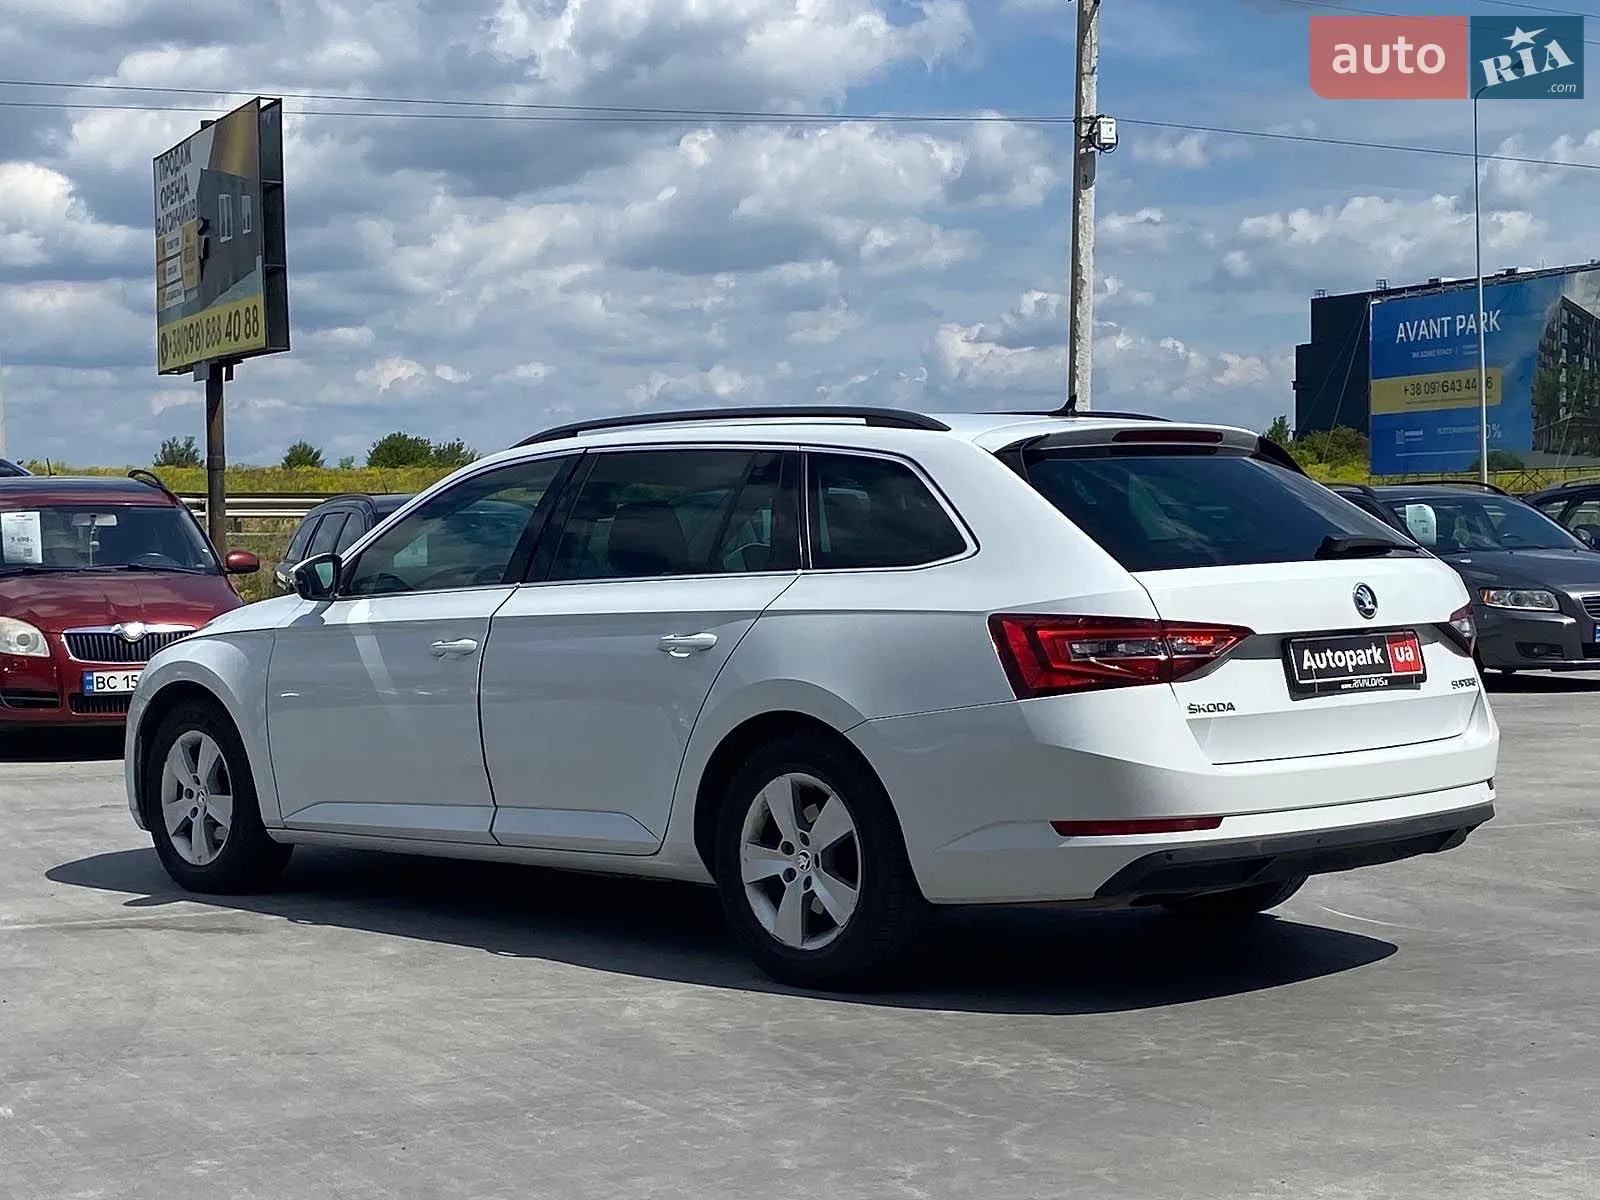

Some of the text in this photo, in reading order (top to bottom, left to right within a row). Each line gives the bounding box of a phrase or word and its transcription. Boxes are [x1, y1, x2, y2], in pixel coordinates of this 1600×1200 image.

[158, 141, 193, 182] ПРОДАЖ
[160, 172, 190, 209] ОРЕНДА
[225, 309, 241, 342] 40
[244, 304, 260, 338] 88
[1395, 309, 1502, 344] AVANT PARK
[1302, 641, 1415, 673] Autopark ua
[95, 675, 118, 690] BC
